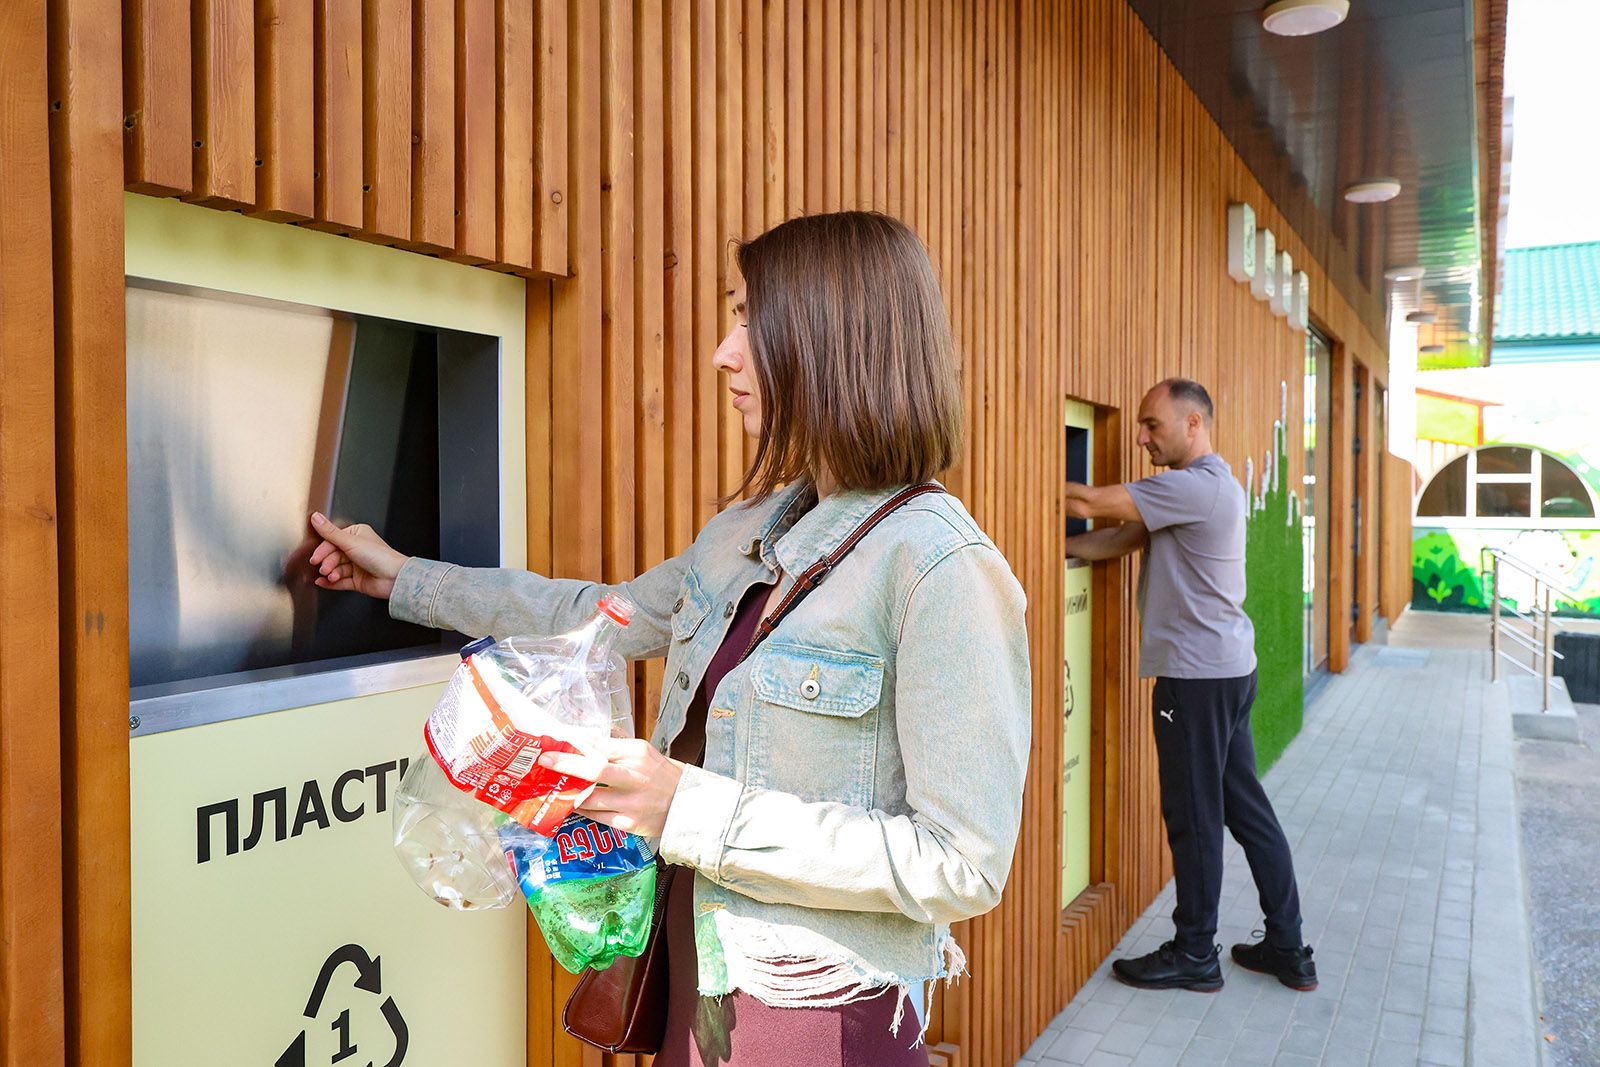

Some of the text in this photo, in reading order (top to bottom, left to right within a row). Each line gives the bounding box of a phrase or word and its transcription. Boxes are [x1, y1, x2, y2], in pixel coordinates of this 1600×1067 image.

[1064, 588, 1088, 616] ИНИЙ
[197, 757, 409, 864] ПЛАСТ
[331, 1009, 357, 1064] 1
